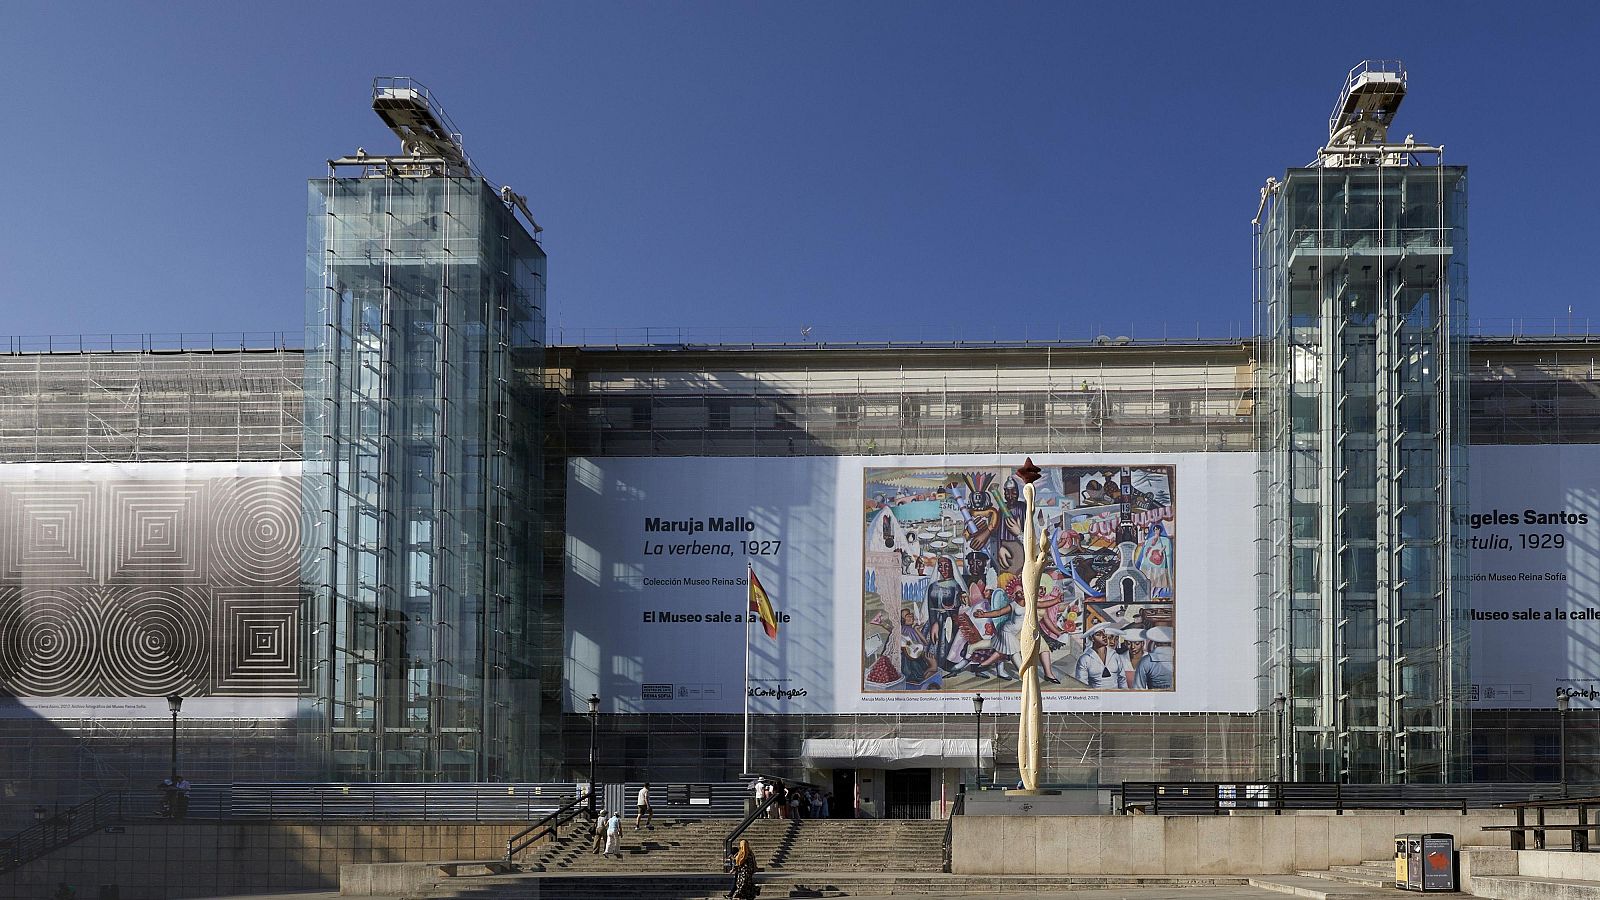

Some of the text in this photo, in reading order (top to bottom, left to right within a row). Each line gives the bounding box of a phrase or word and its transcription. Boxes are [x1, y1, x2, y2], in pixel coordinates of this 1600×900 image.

[1523, 509, 1588, 525] Santos
[645, 517, 755, 535] Maruja Mallo
[644, 540, 781, 557] La verbena, 1927
[1450, 533, 1565, 551] Tertulia, 1929
[643, 577, 681, 586] Colección
[683, 577, 710, 586] Museo
[711, 577, 734, 586] Reina
[1488, 572, 1517, 581] Museo
[1519, 572, 1543, 581] Reina
[1544, 572, 1567, 581] Sofía
[643, 611, 656, 623] El
[659, 611, 702, 623] Museo
[704, 611, 732, 623] sale
[734, 614, 743, 623] a
[1463, 608, 1510, 621] Museo
[1512, 608, 1541, 621] sale
[1543, 611, 1552, 621] a
[1555, 608, 1567, 621] la
[754, 686, 776, 697] Corte
[776, 684, 807, 700] Inglés
[1566, 687, 1589, 698] Corte
